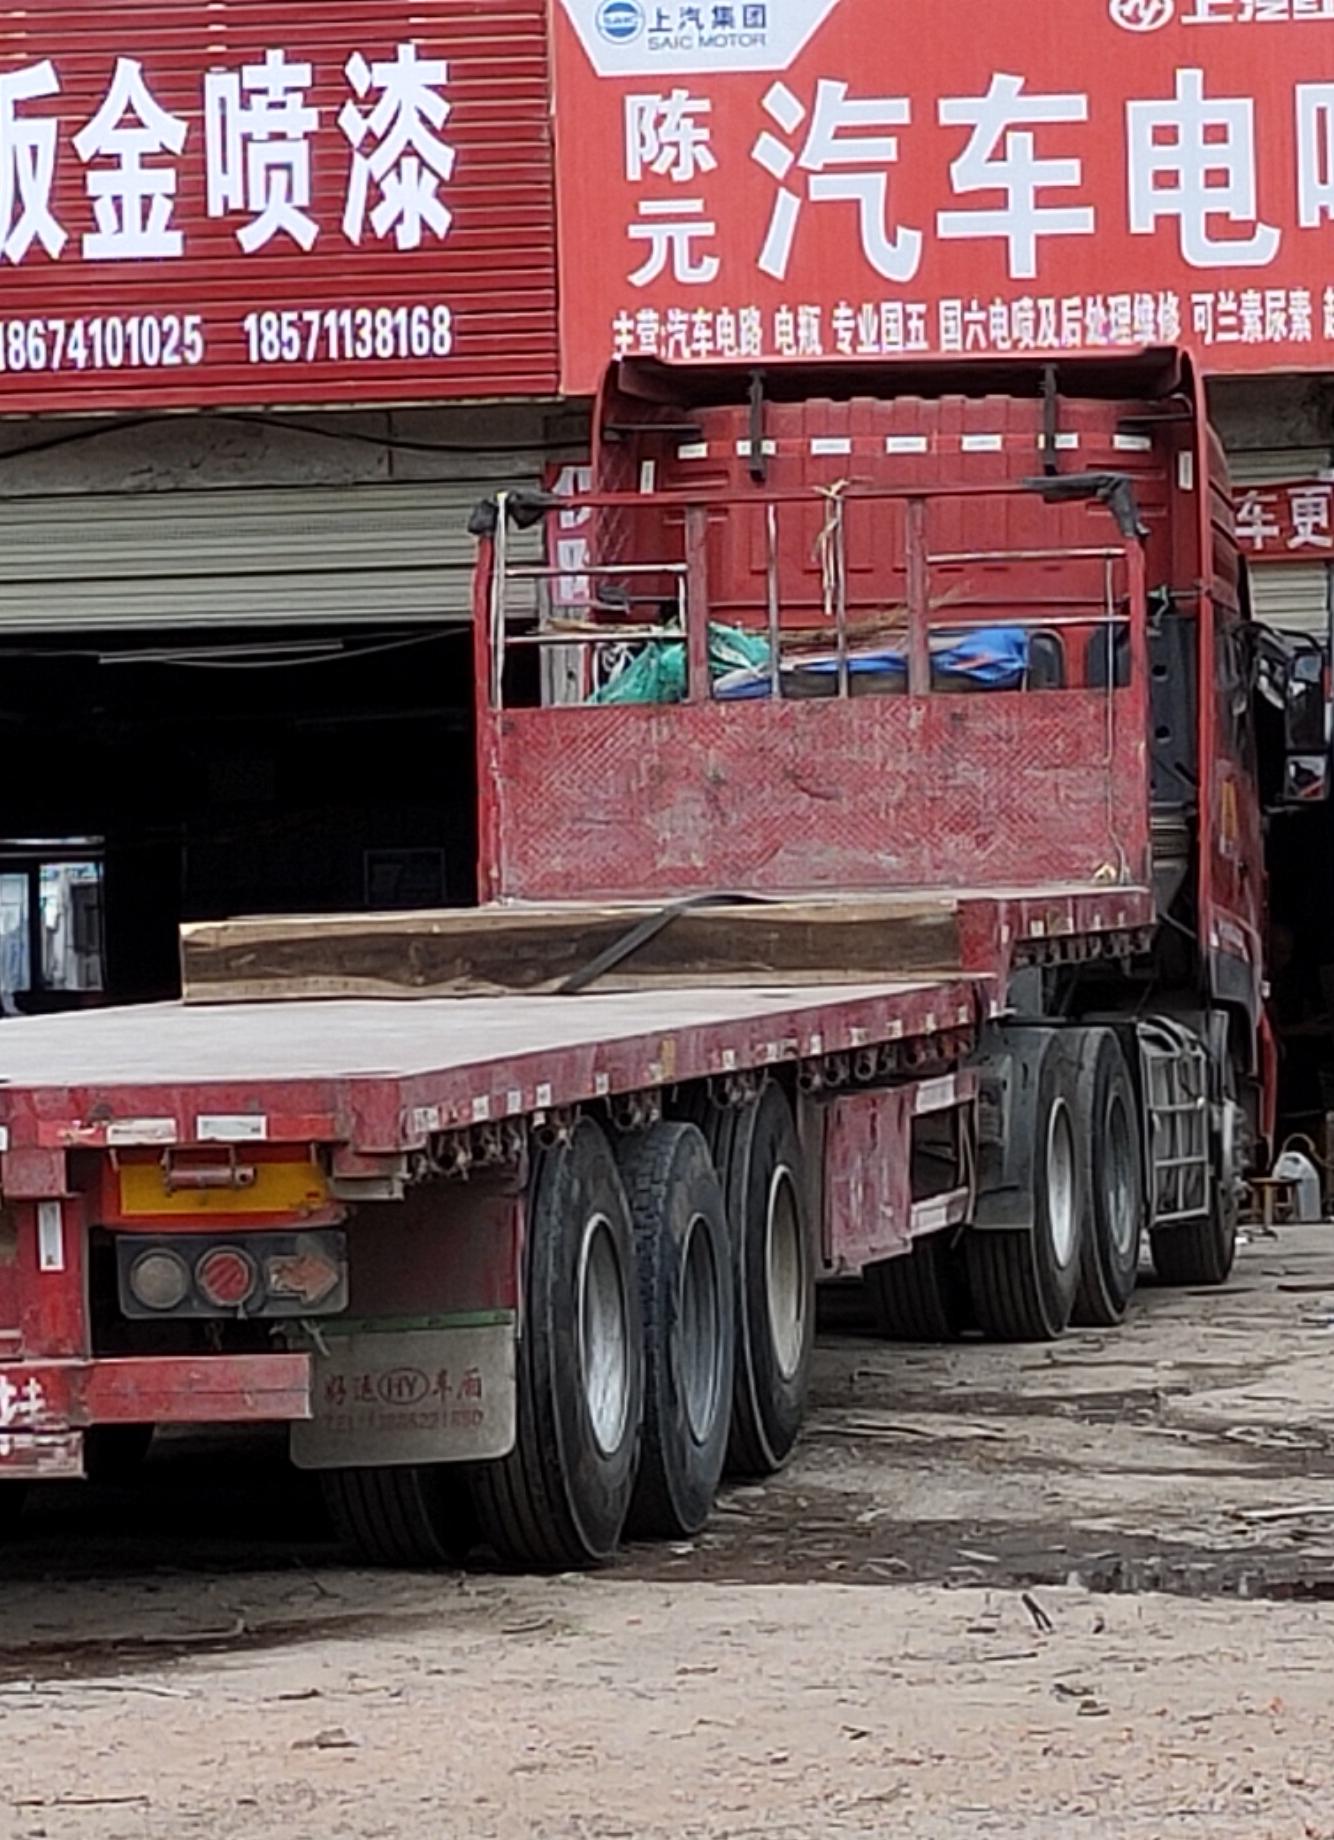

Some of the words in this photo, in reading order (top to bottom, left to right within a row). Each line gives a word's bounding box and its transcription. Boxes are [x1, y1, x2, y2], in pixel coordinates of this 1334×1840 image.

[648, 4, 767, 33] 上汽集团
[648, 36, 693, 50] SAIC
[698, 33, 766, 48] MOTOR
[625, 90, 719, 288] 陈元
[243, 305, 452, 363] 18571138168
[774, 304, 823, 357] 电瓶
[832, 300, 929, 355] 专业国五
[938, 290, 1181, 353] 国六电喷及后处理维修
[1190, 287, 1313, 345] 可兰素尿素
